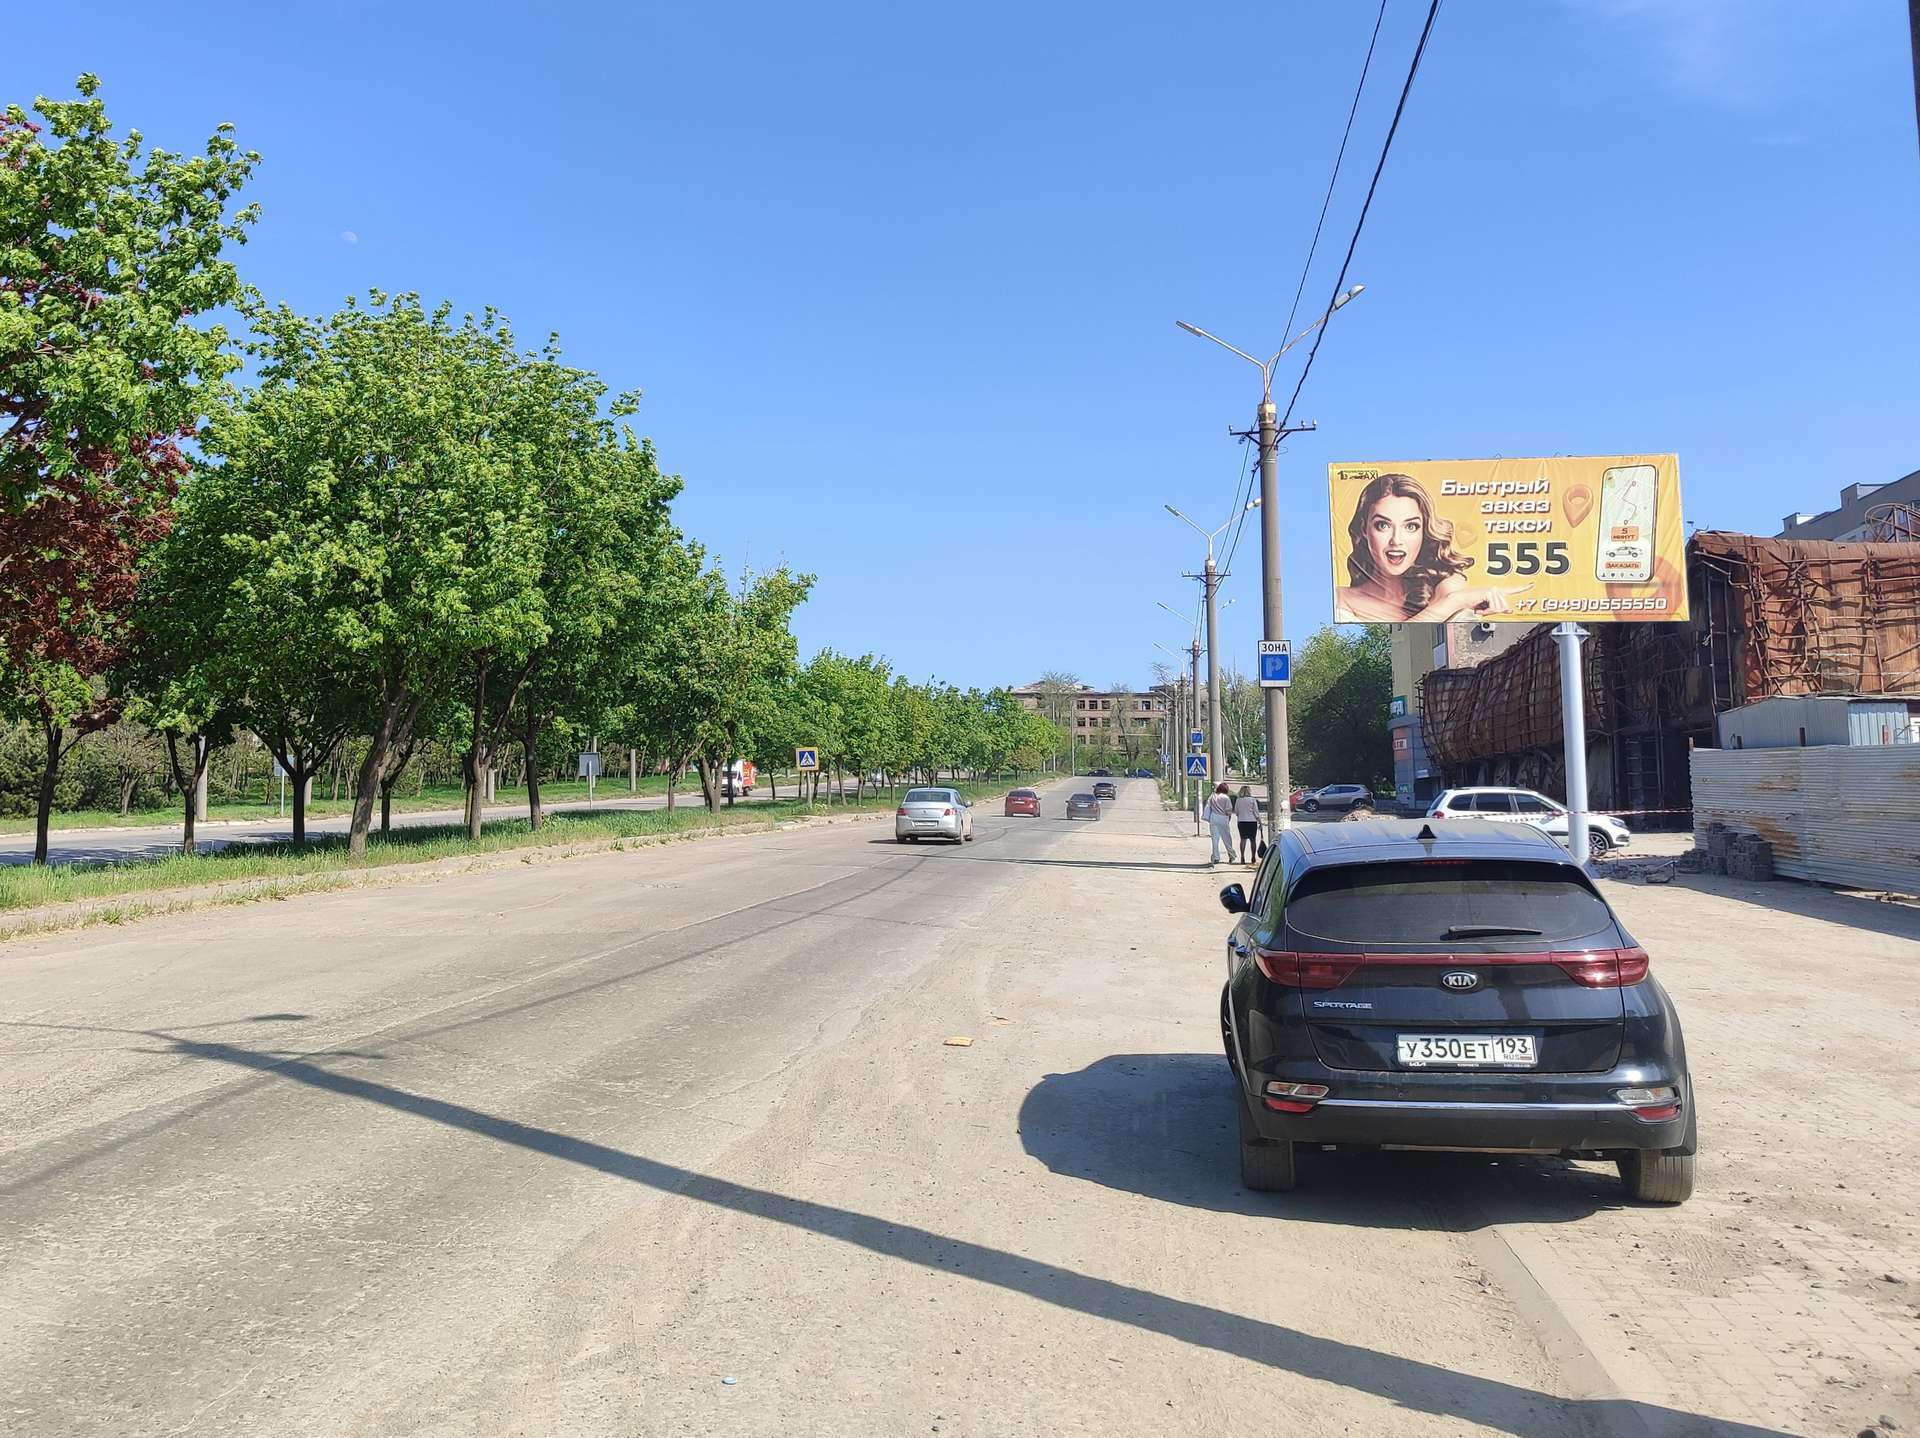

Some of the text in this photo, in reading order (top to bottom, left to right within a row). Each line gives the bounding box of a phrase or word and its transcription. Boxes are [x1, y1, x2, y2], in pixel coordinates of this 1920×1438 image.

[1440, 478, 1550, 497] Быстрый
[1481, 500, 1551, 514] заказ
[1485, 520, 1553, 533] такси
[1486, 541, 1571, 576] 555
[1516, 598, 1668, 612] +7 (949)0555550
[1261, 643, 1288, 652] ЗОНА
[1448, 974, 1473, 987] KIA
[1313, 1001, 1373, 1009] SPORTAGE
[1495, 1038, 1528, 1054] 193
